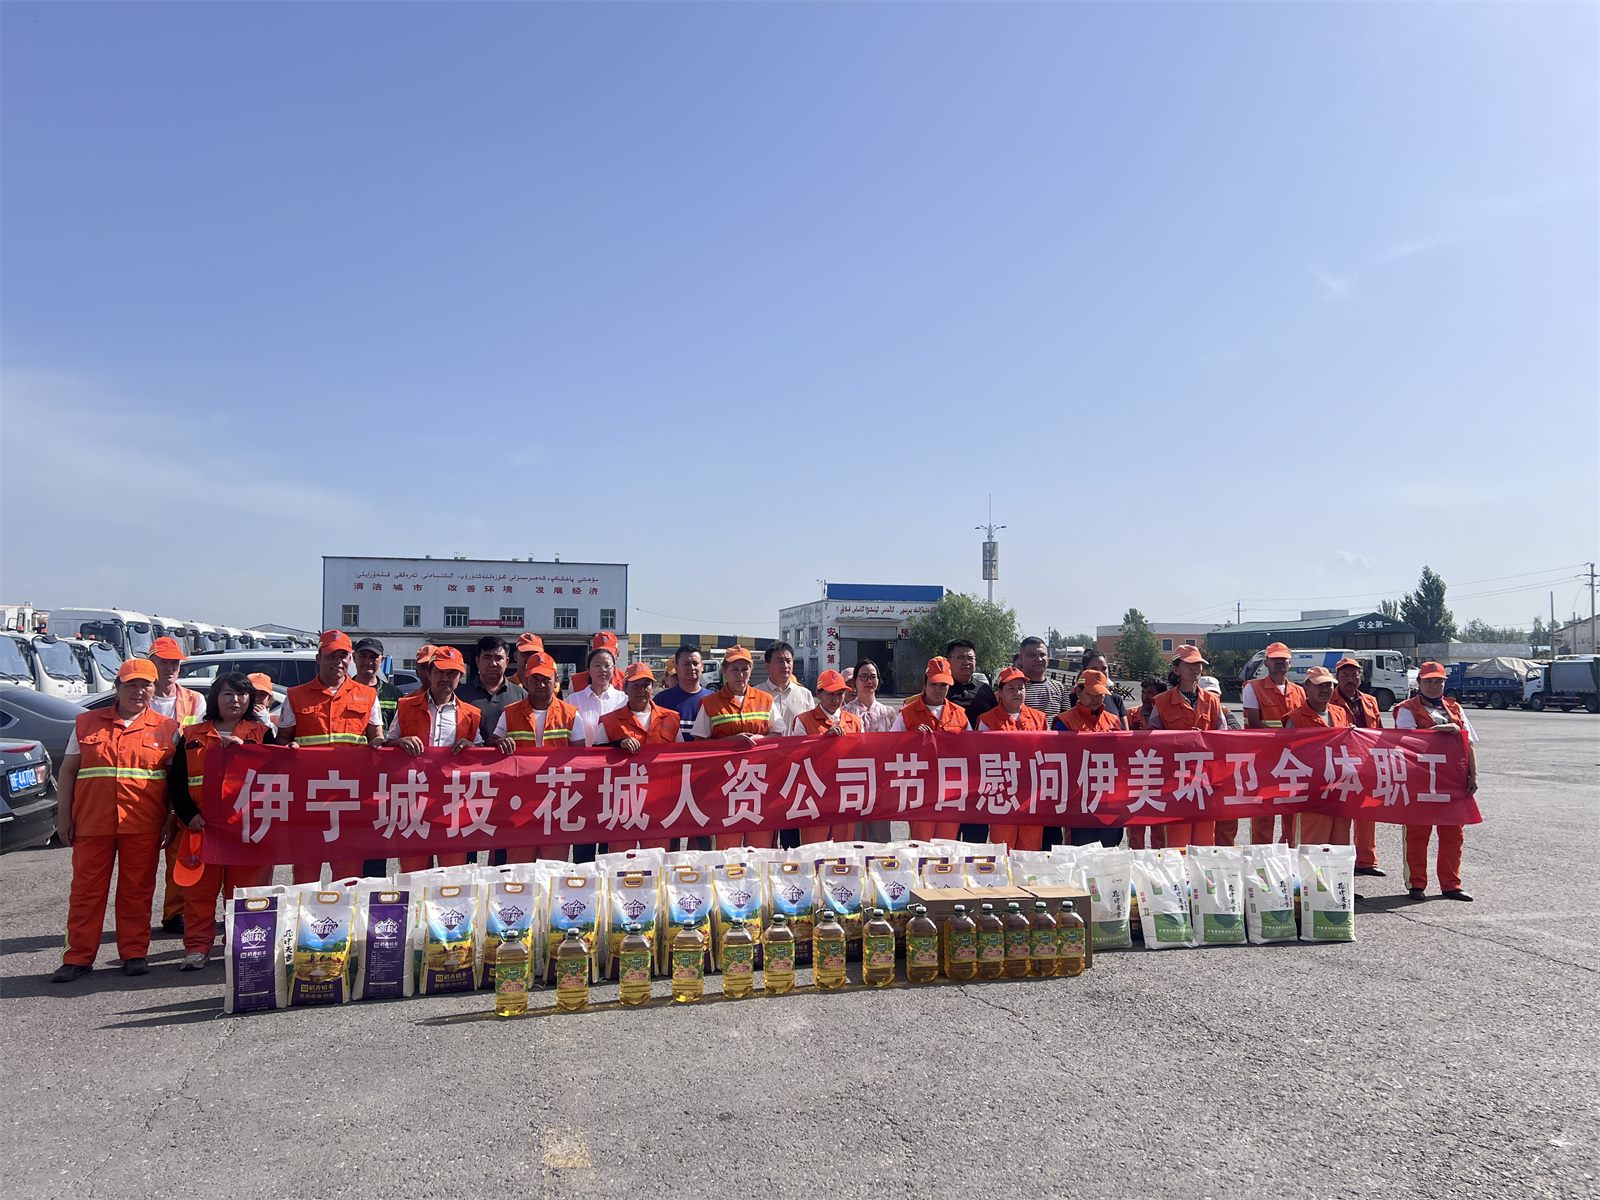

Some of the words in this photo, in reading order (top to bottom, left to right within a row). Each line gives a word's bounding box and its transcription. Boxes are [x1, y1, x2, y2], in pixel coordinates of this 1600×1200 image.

[353, 582, 423, 591] 清洁城市
[447, 584, 513, 594] 改善环境
[535, 586, 598, 595] 发展经济
[1357, 620, 1392, 629] 安全第一
